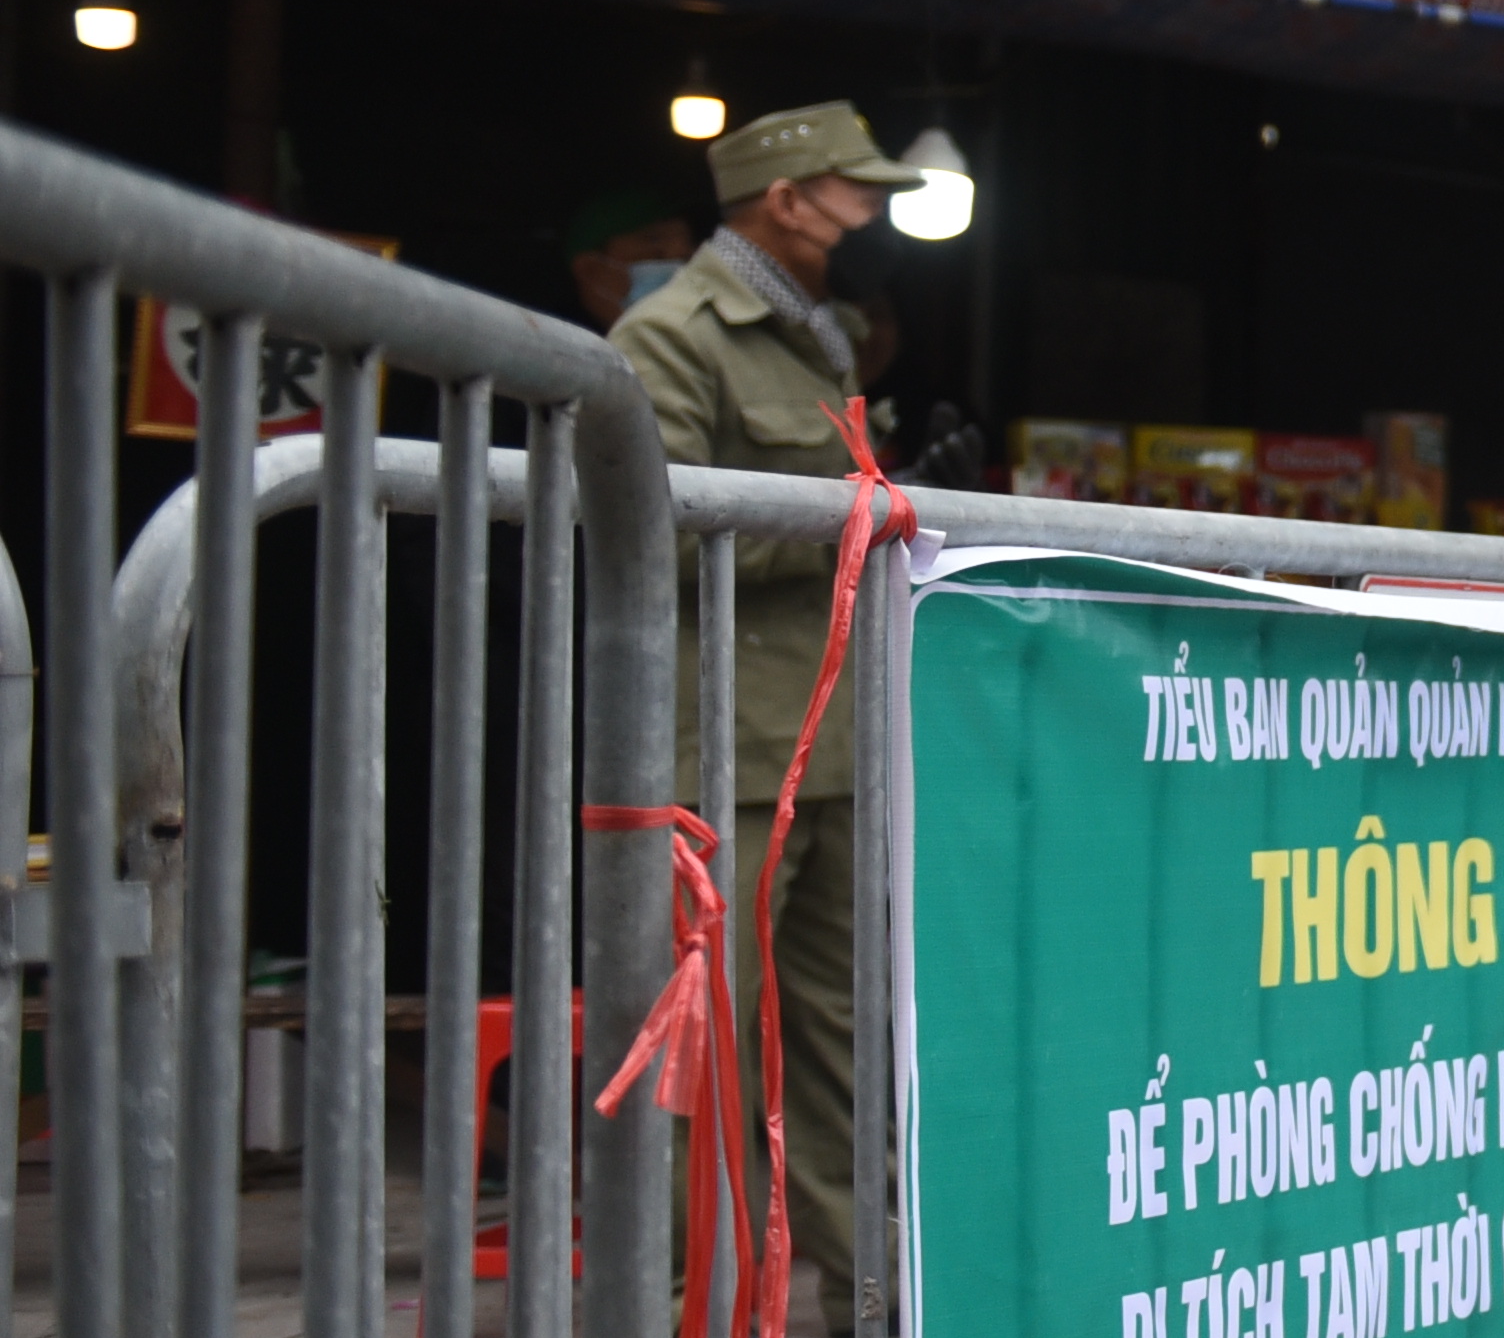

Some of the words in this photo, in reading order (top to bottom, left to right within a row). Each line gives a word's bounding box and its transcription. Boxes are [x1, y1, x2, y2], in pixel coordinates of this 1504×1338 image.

[1142, 642, 1216, 761] TIỂU
[1225, 678, 1288, 760] BAN
[1301, 655, 1398, 768] QUẢN
[1409, 656, 1490, 766] QUẢN
[1252, 816, 1497, 986] THÔNG
[1108, 1054, 1170, 1225] ĐỂ
[1183, 1060, 1335, 1210] PHÒNG
[1350, 1025, 1487, 1177] CHỐNG
[1397, 1193, 1490, 1331] THỜI
